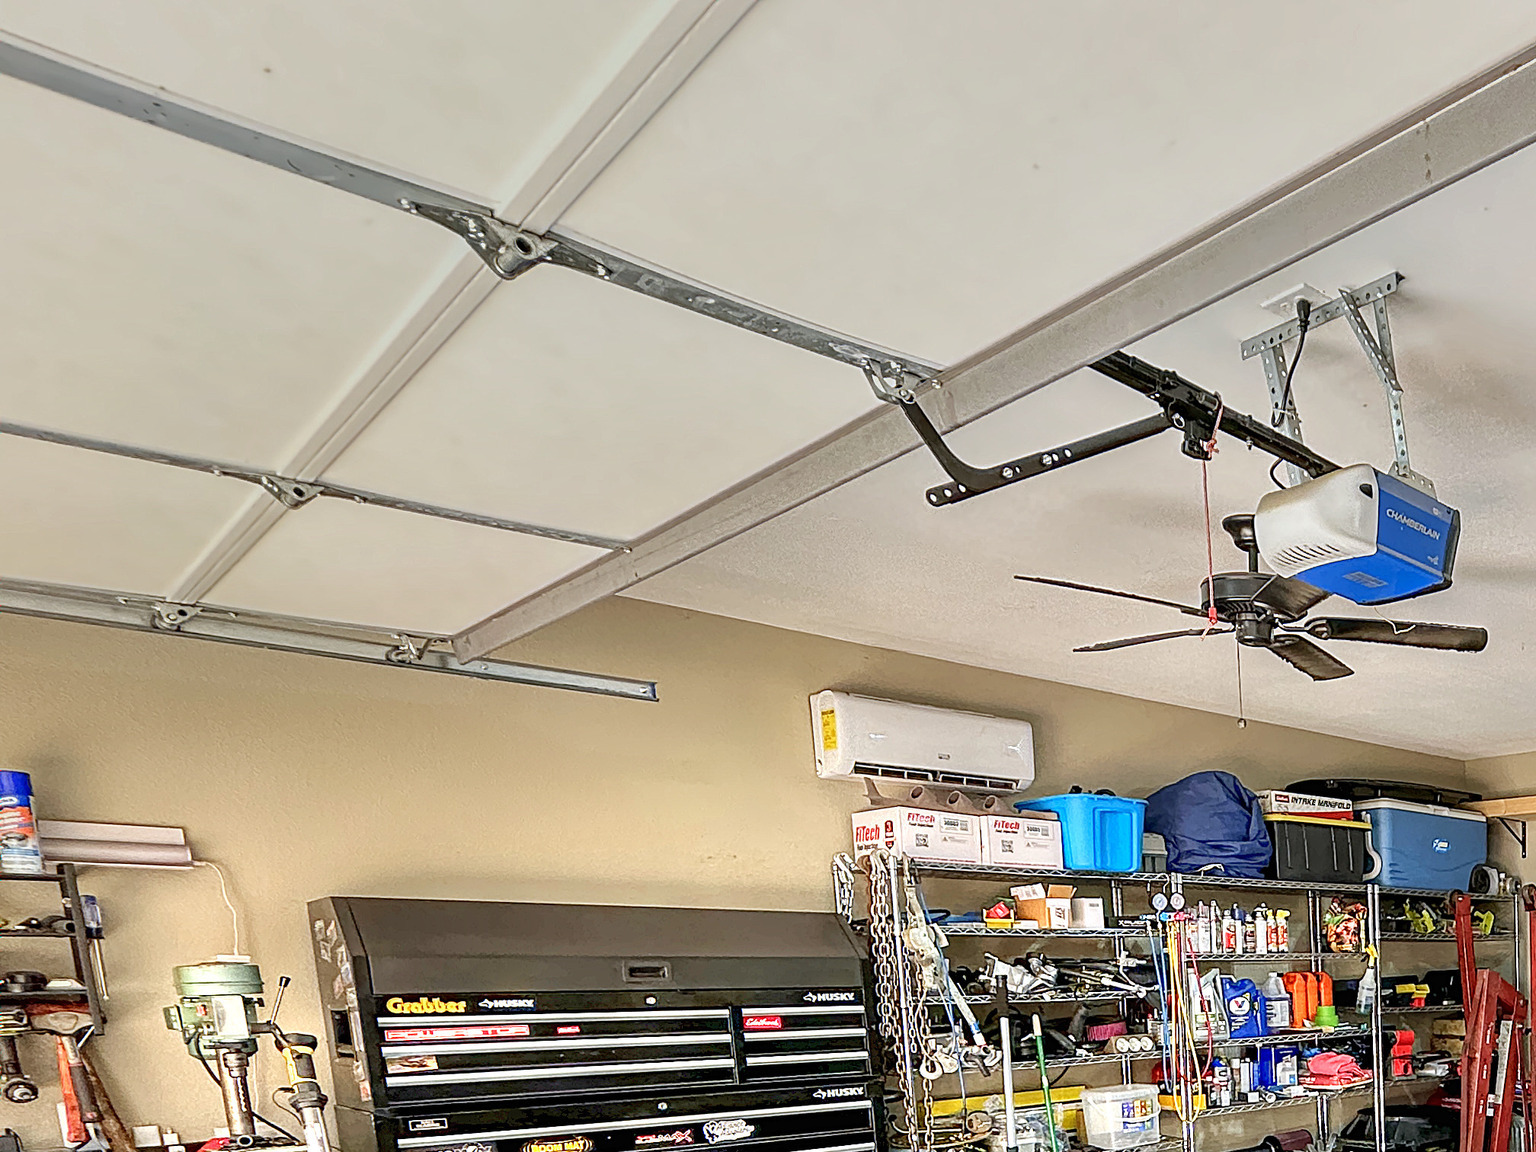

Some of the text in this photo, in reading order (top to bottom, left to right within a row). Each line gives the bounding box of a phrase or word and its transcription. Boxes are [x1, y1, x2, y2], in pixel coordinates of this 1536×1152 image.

[1386, 508, 1441, 540] CHAMBERLAIN
[1291, 796, 1316, 806] INTAKE
[817, 992, 855, 1002] HUSKY
[386, 997, 467, 1014] Grabber
[493, 998, 535, 1009] HUSKY
[826, 1086, 864, 1098] HUSKY
[564, 1140, 585, 1152] MAT
